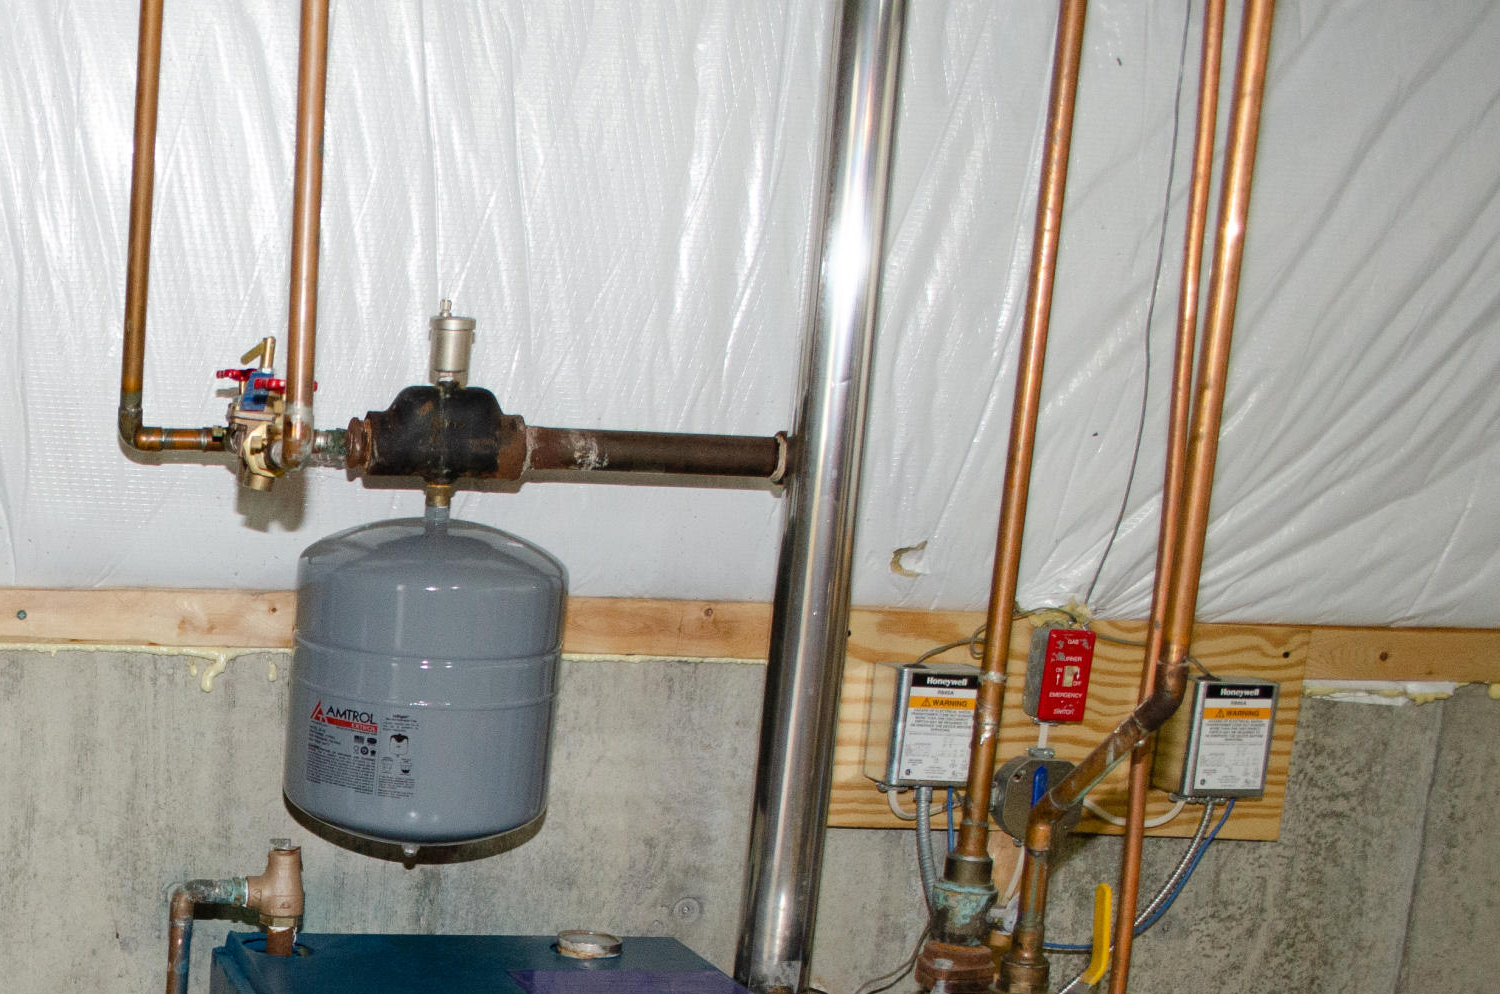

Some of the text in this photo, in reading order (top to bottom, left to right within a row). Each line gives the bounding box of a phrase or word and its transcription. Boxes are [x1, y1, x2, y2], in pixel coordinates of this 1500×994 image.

[926, 676, 968, 687] Honeywell
[1220, 688, 1260, 698] Honeywell
[932, 699, 967, 707] WARNING
[325, 705, 378, 725] AMTROL
